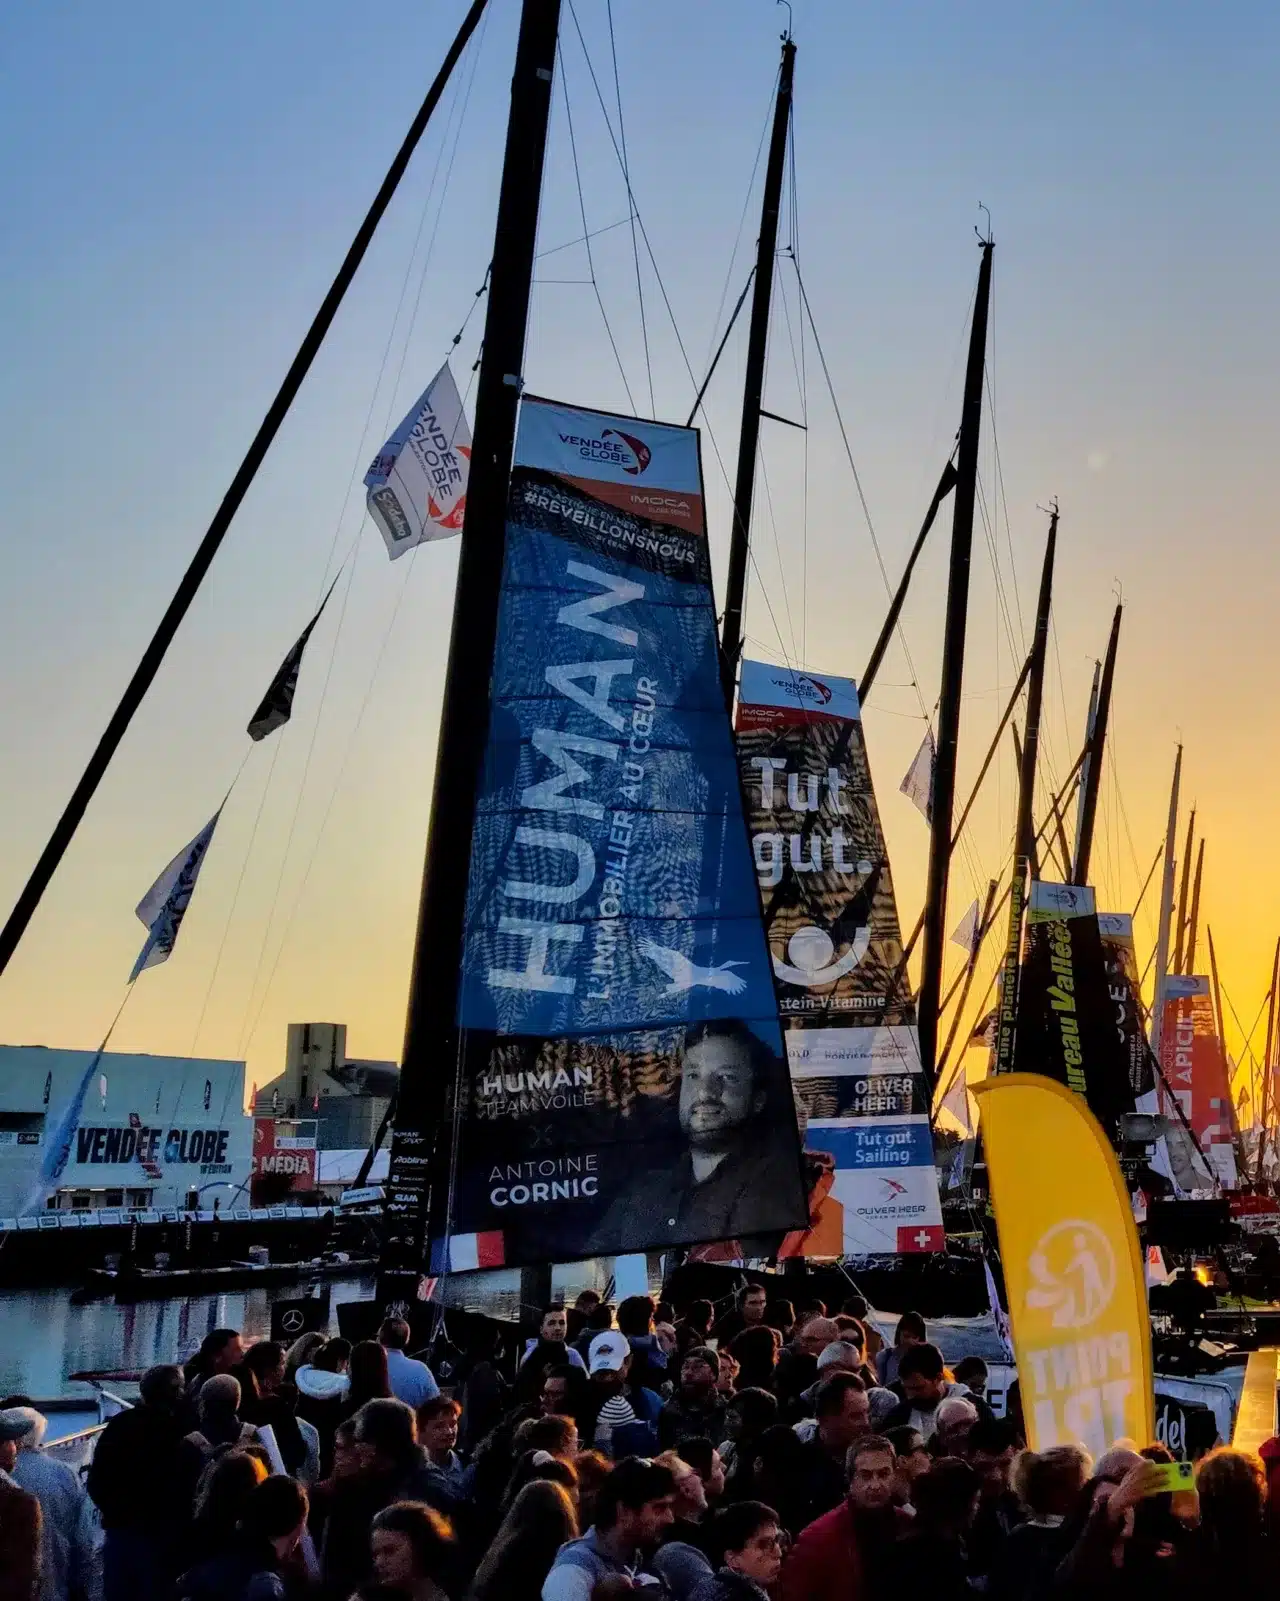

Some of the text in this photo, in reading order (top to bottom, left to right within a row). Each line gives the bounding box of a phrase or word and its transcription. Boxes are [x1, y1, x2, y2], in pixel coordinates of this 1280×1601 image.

[419, 399, 463, 484] ENDÉE
[558, 433, 624, 453] VENDÉE
[410, 421, 453, 501] GLOBE
[579, 447, 631, 464] GLOBE
[630, 495, 690, 509] IMOCA
[741, 708, 785, 718] IMOCA
[486, 559, 646, 995] HUMAN
[750, 756, 850, 816] Tut
[588, 676, 659, 1001] L'IMMOBILIER AU CŒUR
[752, 826, 874, 887] gut.
[820, 994, 886, 1009] Vitamine
[1060, 1015, 1087, 1094] ureau
[1164, 1039, 1174, 1085] GROUPE
[482, 1065, 594, 1097] HUMAN
[854, 1079, 913, 1095] OLIVER
[484, 1091, 596, 1116] TEAM VOILE
[854, 1097, 897, 1112] HEER
[76, 1126, 163, 1164] VENDÉE
[164, 1129, 230, 1164] GLOBE
[856, 1131, 917, 1148] Tut gut.
[261, 1151, 311, 1175] MÉDIA
[393, 1155, 429, 1165] Robline
[488, 1153, 599, 1183] ANTOINE
[855, 1147, 910, 1165] Sailing
[489, 1175, 599, 1208] CORNIC
[856, 1204, 928, 1215] OLIVER HEER
